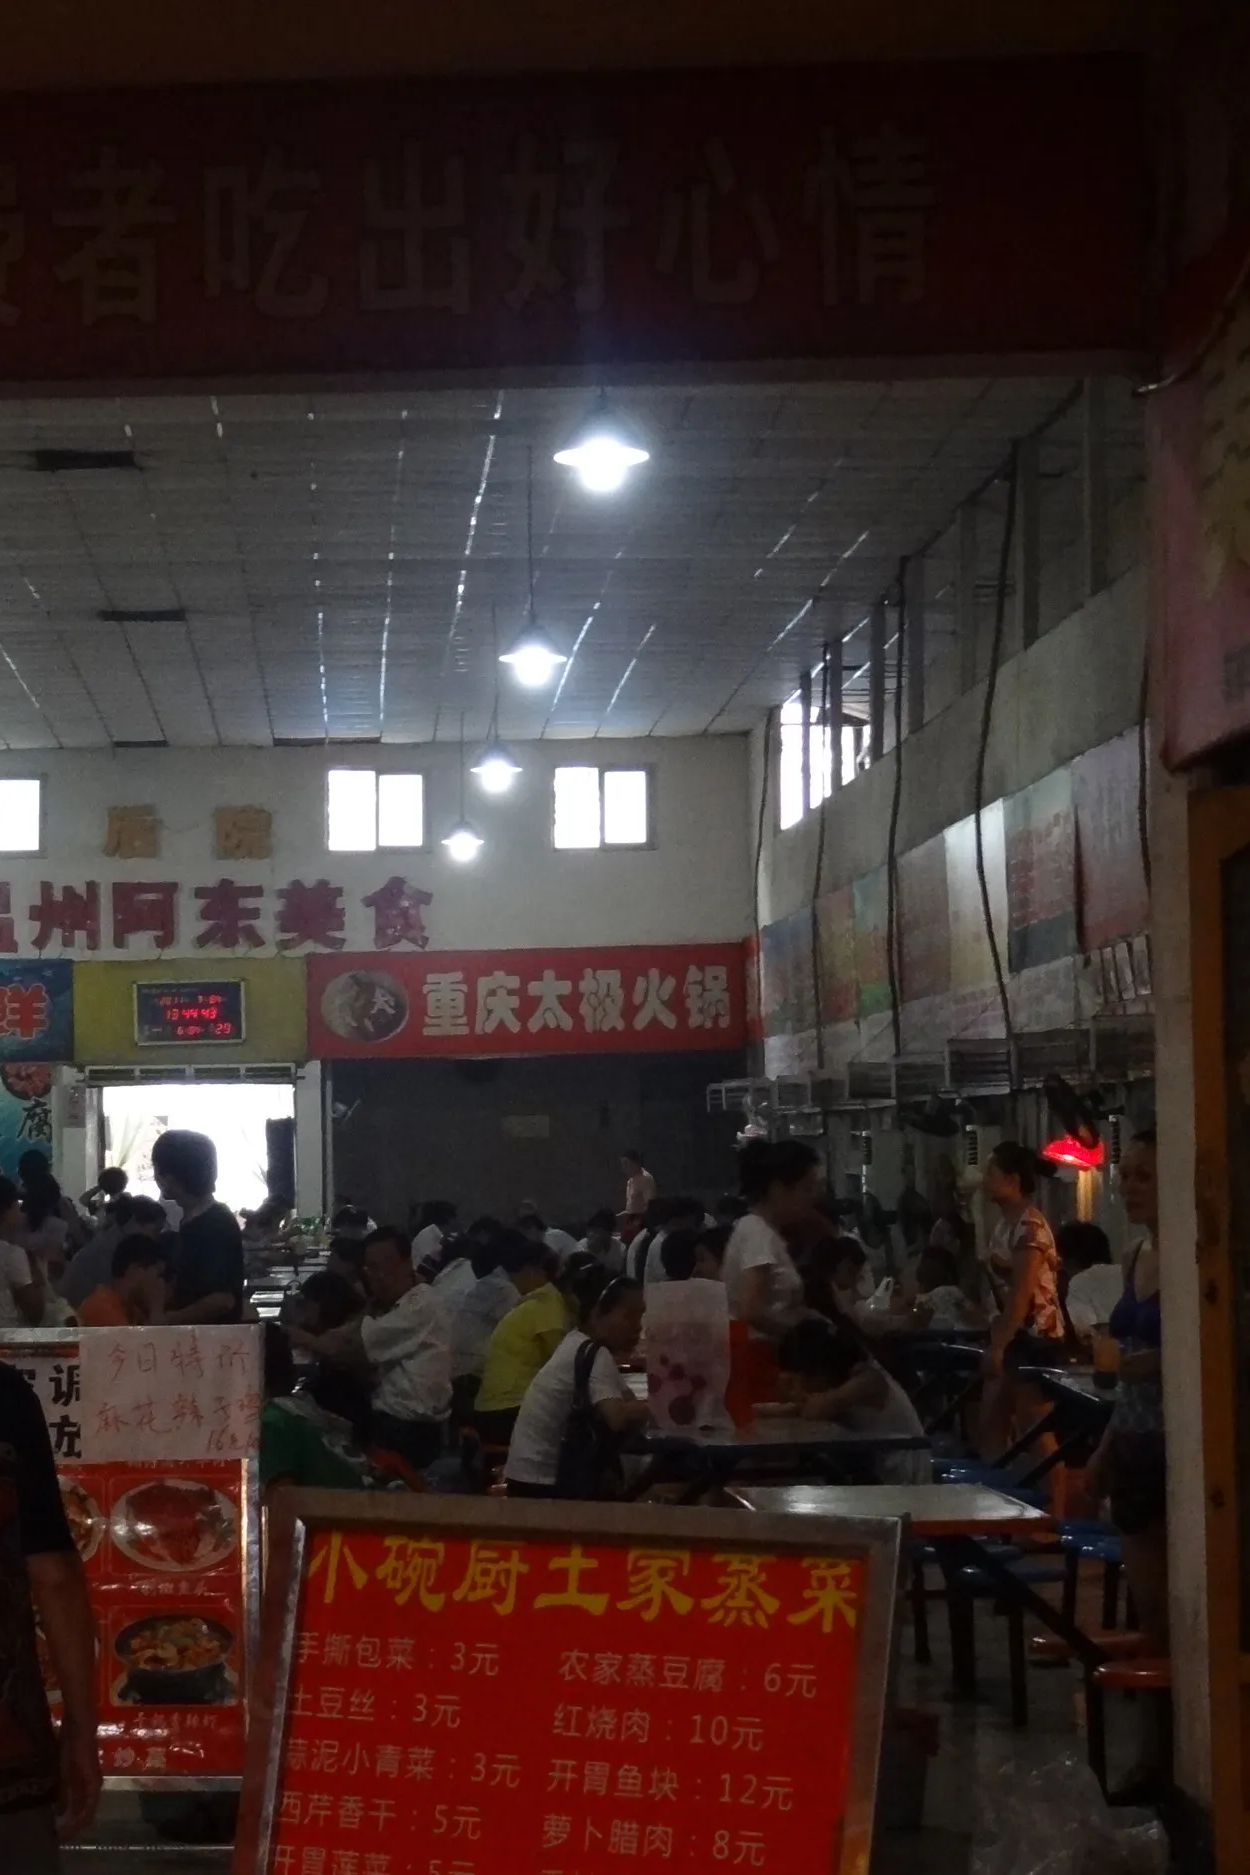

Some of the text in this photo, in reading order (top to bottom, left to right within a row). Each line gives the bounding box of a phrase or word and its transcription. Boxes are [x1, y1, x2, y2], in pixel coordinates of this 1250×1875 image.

[421, 964, 731, 1036] 重庆太极火锅
[308, 1530, 861, 1634] 小碗厨土家蒸菜
